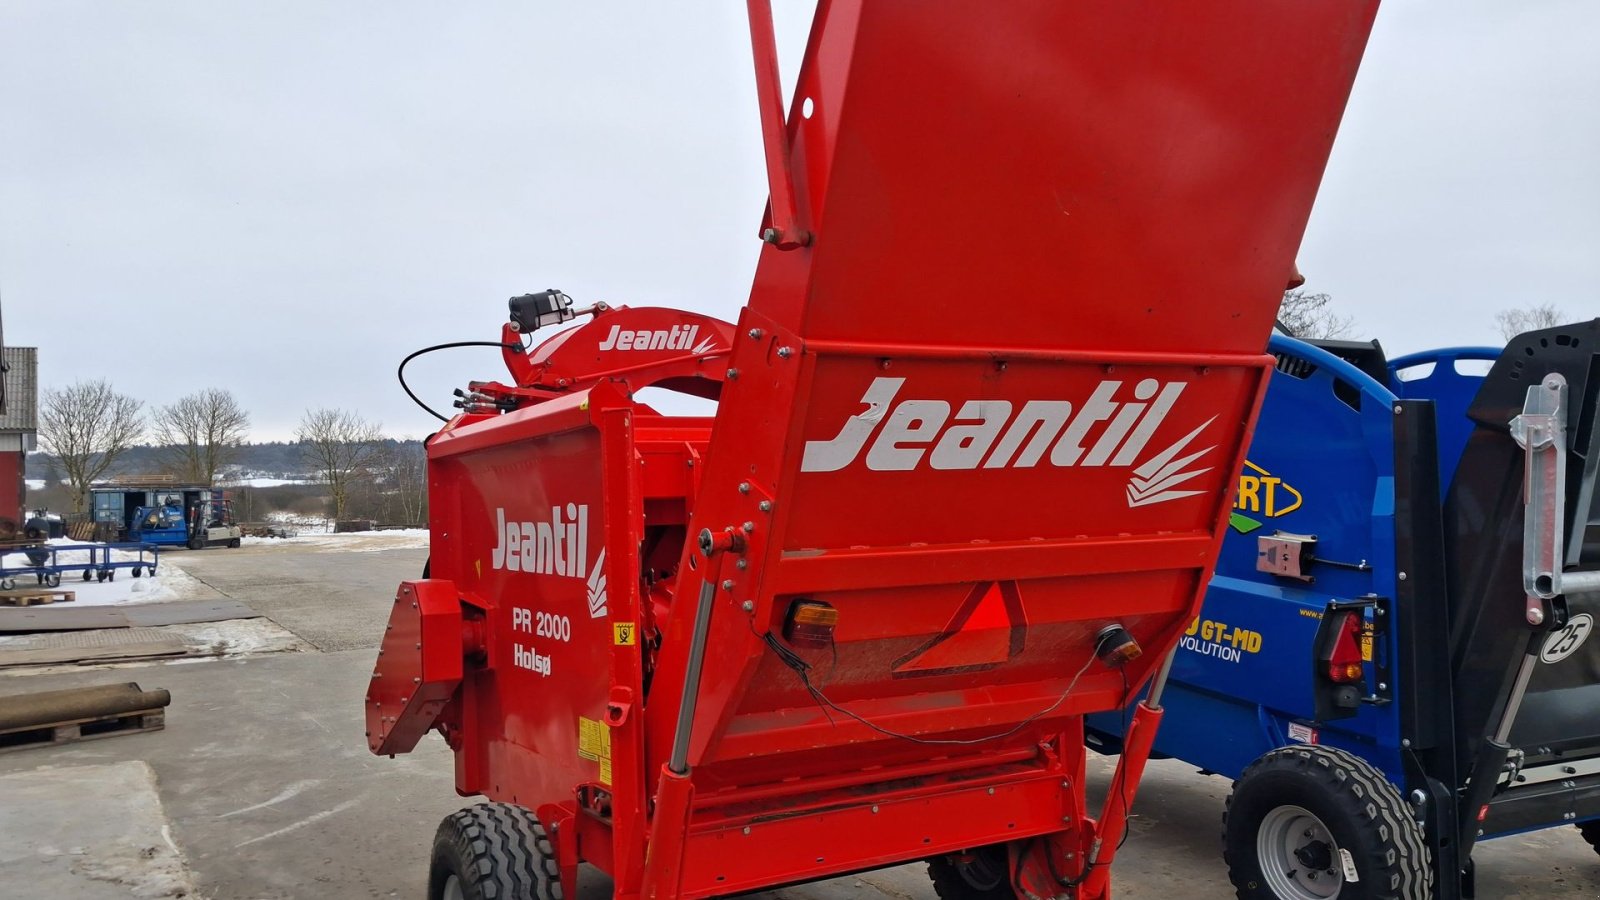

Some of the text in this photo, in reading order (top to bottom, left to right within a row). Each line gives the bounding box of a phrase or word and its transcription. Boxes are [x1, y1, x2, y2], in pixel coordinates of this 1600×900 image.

[599, 324, 699, 351] Jeantil
[800, 376, 1188, 472] Jeantil
[1233, 475, 1281, 517] RT
[492, 502, 588, 579] Jeantil
[513, 607, 571, 643] PR 2000
[1201, 619, 1262, 653] GT-MD
[1547, 623, 1588, 655] 25
[514, 643, 551, 677] Holsø
